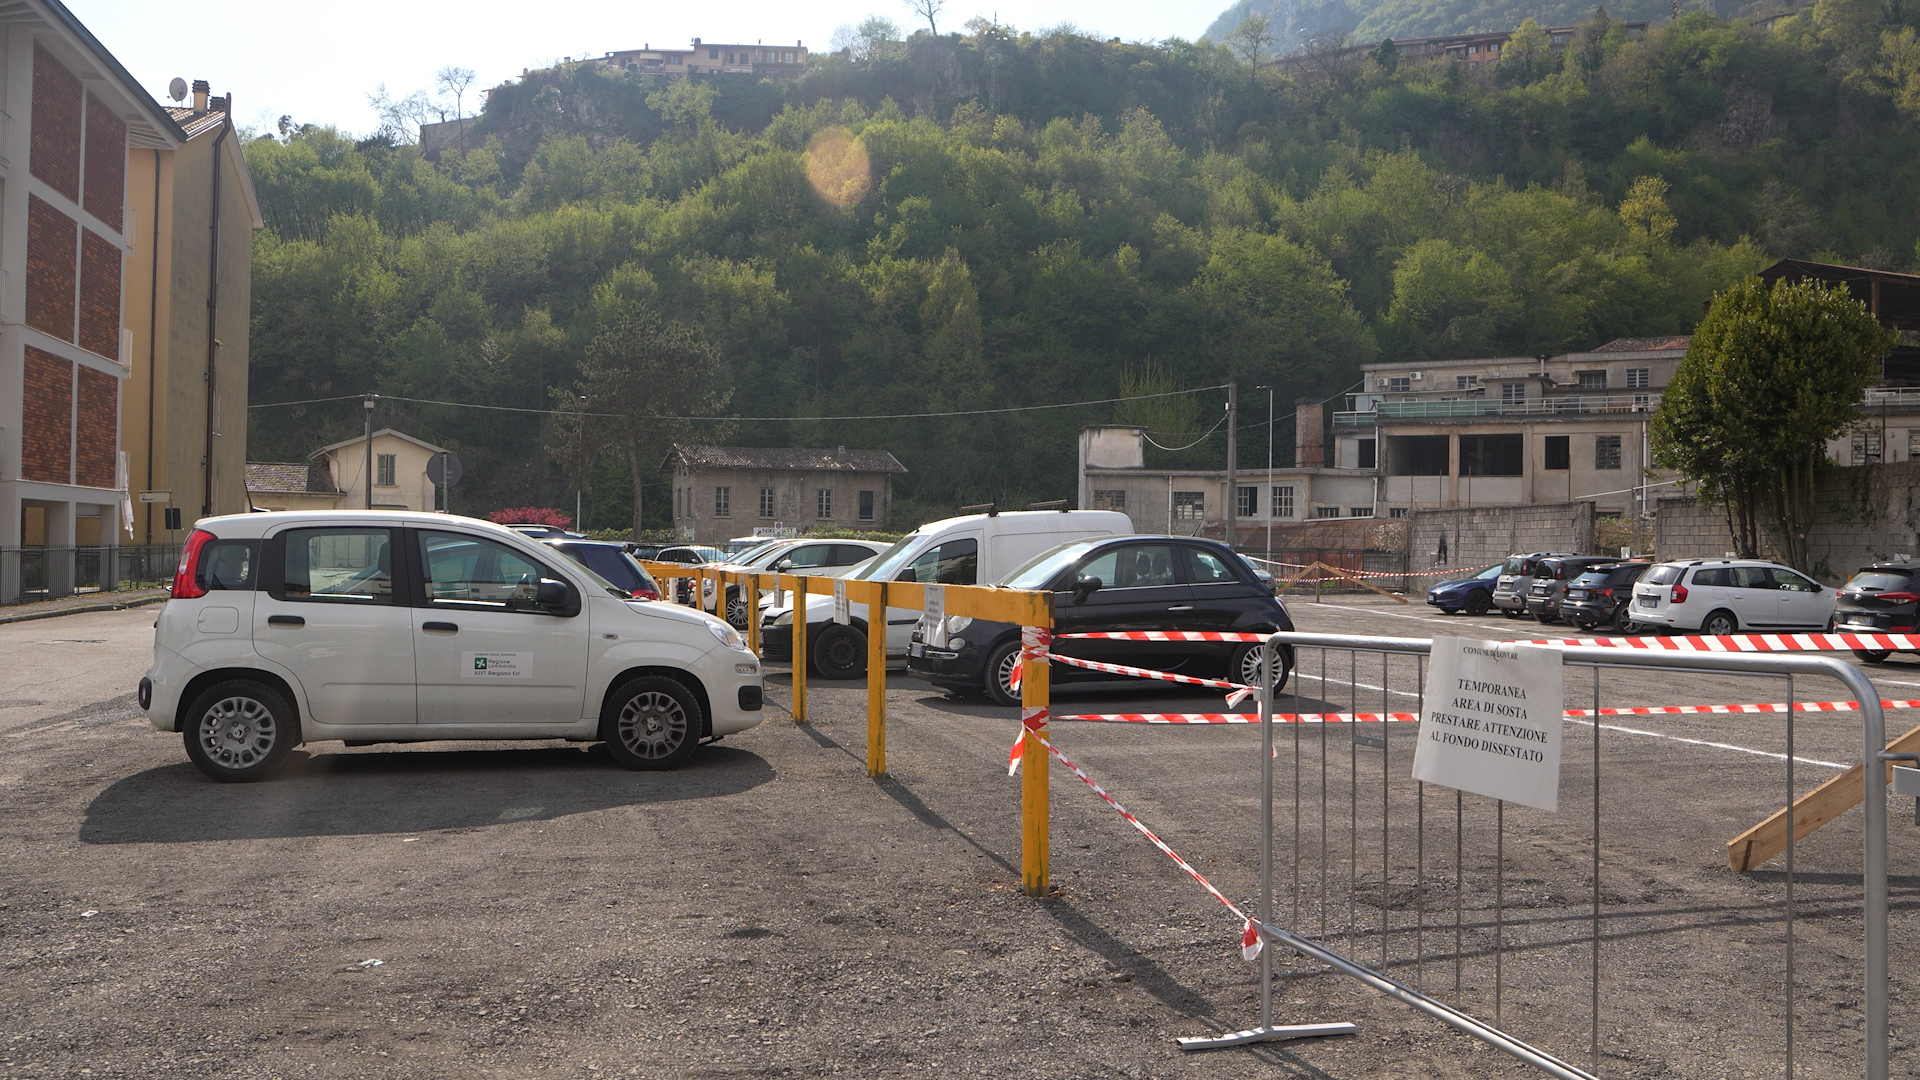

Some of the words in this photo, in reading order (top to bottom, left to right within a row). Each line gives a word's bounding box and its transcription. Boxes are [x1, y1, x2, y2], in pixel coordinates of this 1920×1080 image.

[1458, 678, 1527, 700] TEMPORANEA
[1452, 697, 1481, 711] AREA
[1484, 701, 1495, 714] DI
[1496, 703, 1528, 720] SOSTA
[1431, 711, 1481, 731] PRESTARE
[1482, 721, 1548, 744] ATTENZIONE
[1429, 730, 1441, 742] AL
[1443, 732, 1479, 750] FONDO
[1481, 740, 1544, 763] DISSESTATO
